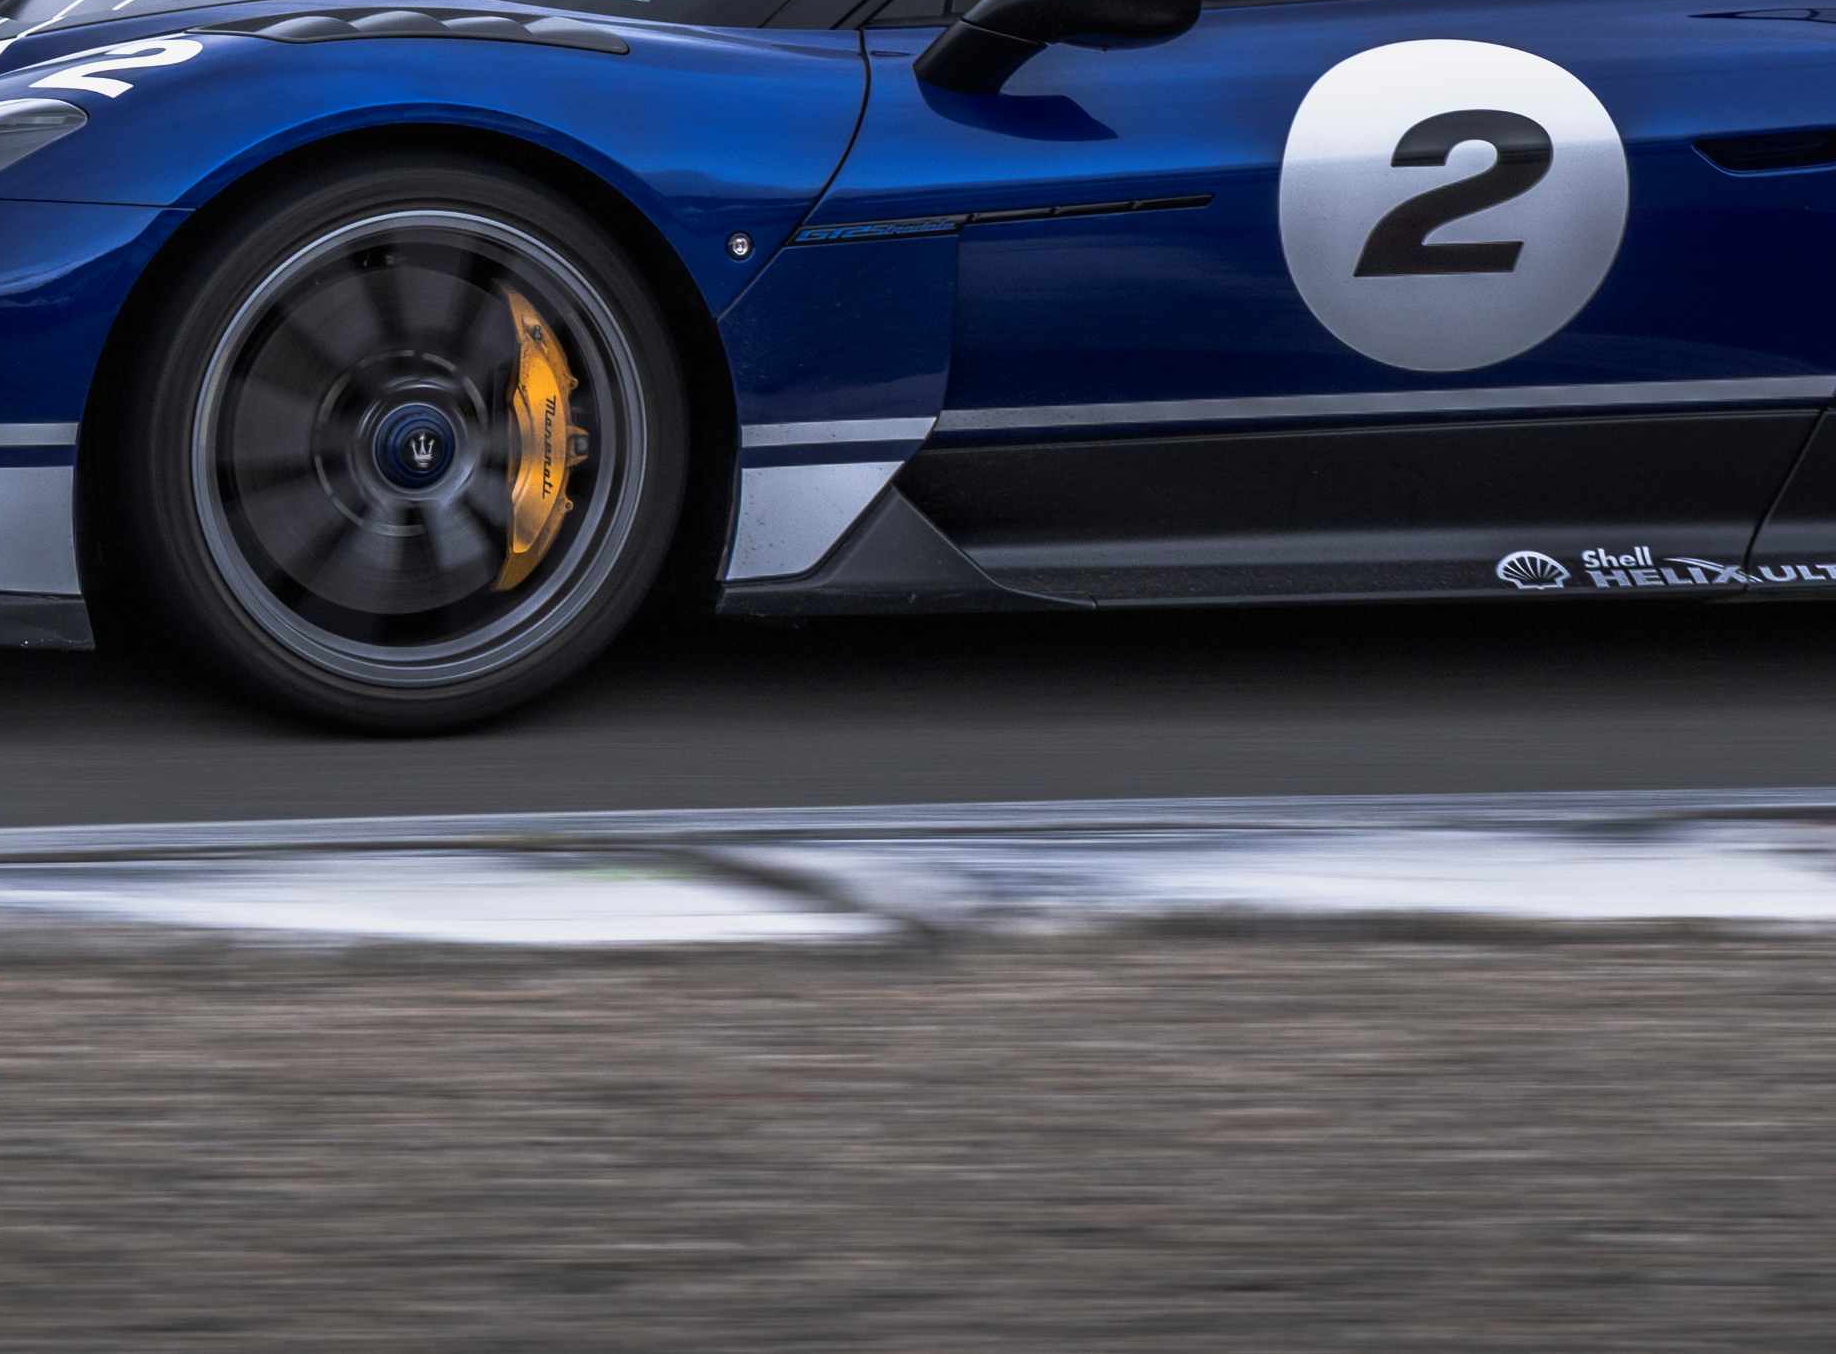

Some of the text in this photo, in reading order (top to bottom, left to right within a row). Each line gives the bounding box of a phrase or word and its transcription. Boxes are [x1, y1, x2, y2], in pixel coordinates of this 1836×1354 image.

[28, 39, 203, 98] 2
[1352, 108, 1554, 278] 2
[542, 396, 556, 499] Maserati
[1581, 545, 1653, 568] Shell
[1585, 563, 1756, 589] HELIX
